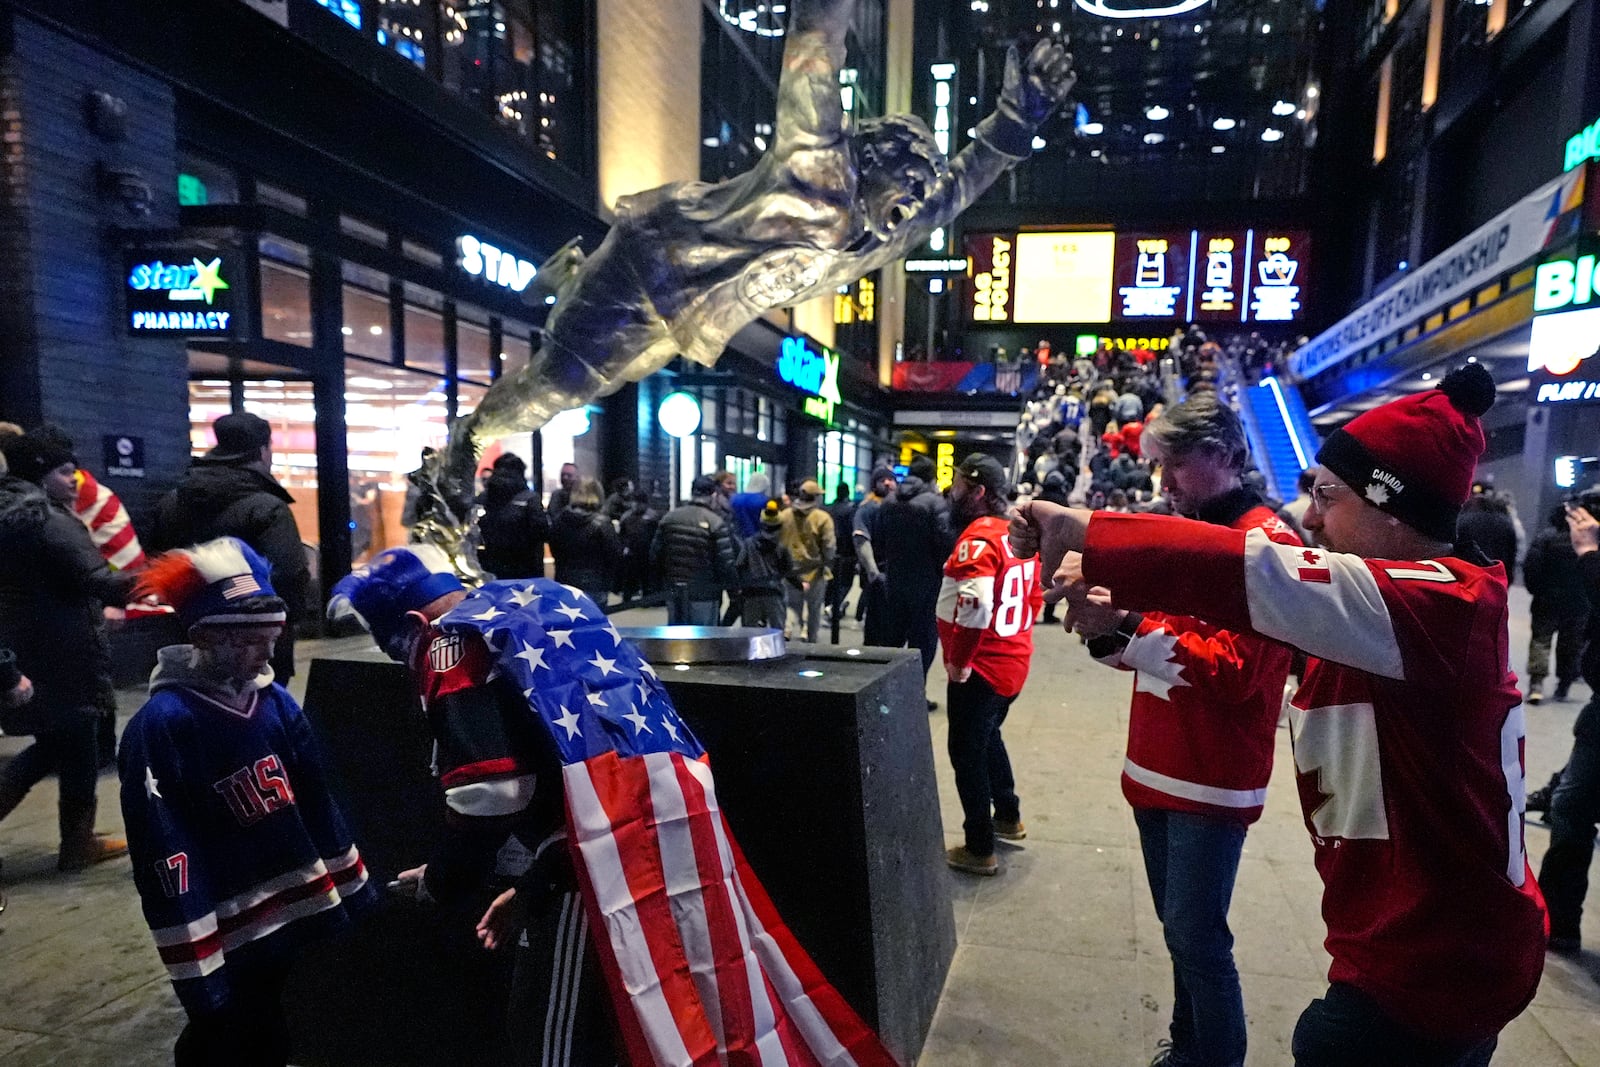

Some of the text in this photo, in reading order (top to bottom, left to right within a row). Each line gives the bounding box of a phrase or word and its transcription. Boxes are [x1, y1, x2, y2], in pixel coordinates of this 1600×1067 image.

[1137, 239, 1168, 253] YES
[990, 236, 1011, 320] POLICY
[1396, 223, 1511, 319] CHAMPIONSHIP
[973, 272, 992, 320] BAG
[132, 311, 230, 329] PHARMACY
[1537, 381, 1586, 402] PLAY
[1371, 468, 1405, 494] CANADA
[958, 539, 987, 562] 87
[995, 560, 1036, 638] 87
[213, 754, 296, 828] US
[154, 851, 189, 898] 17
